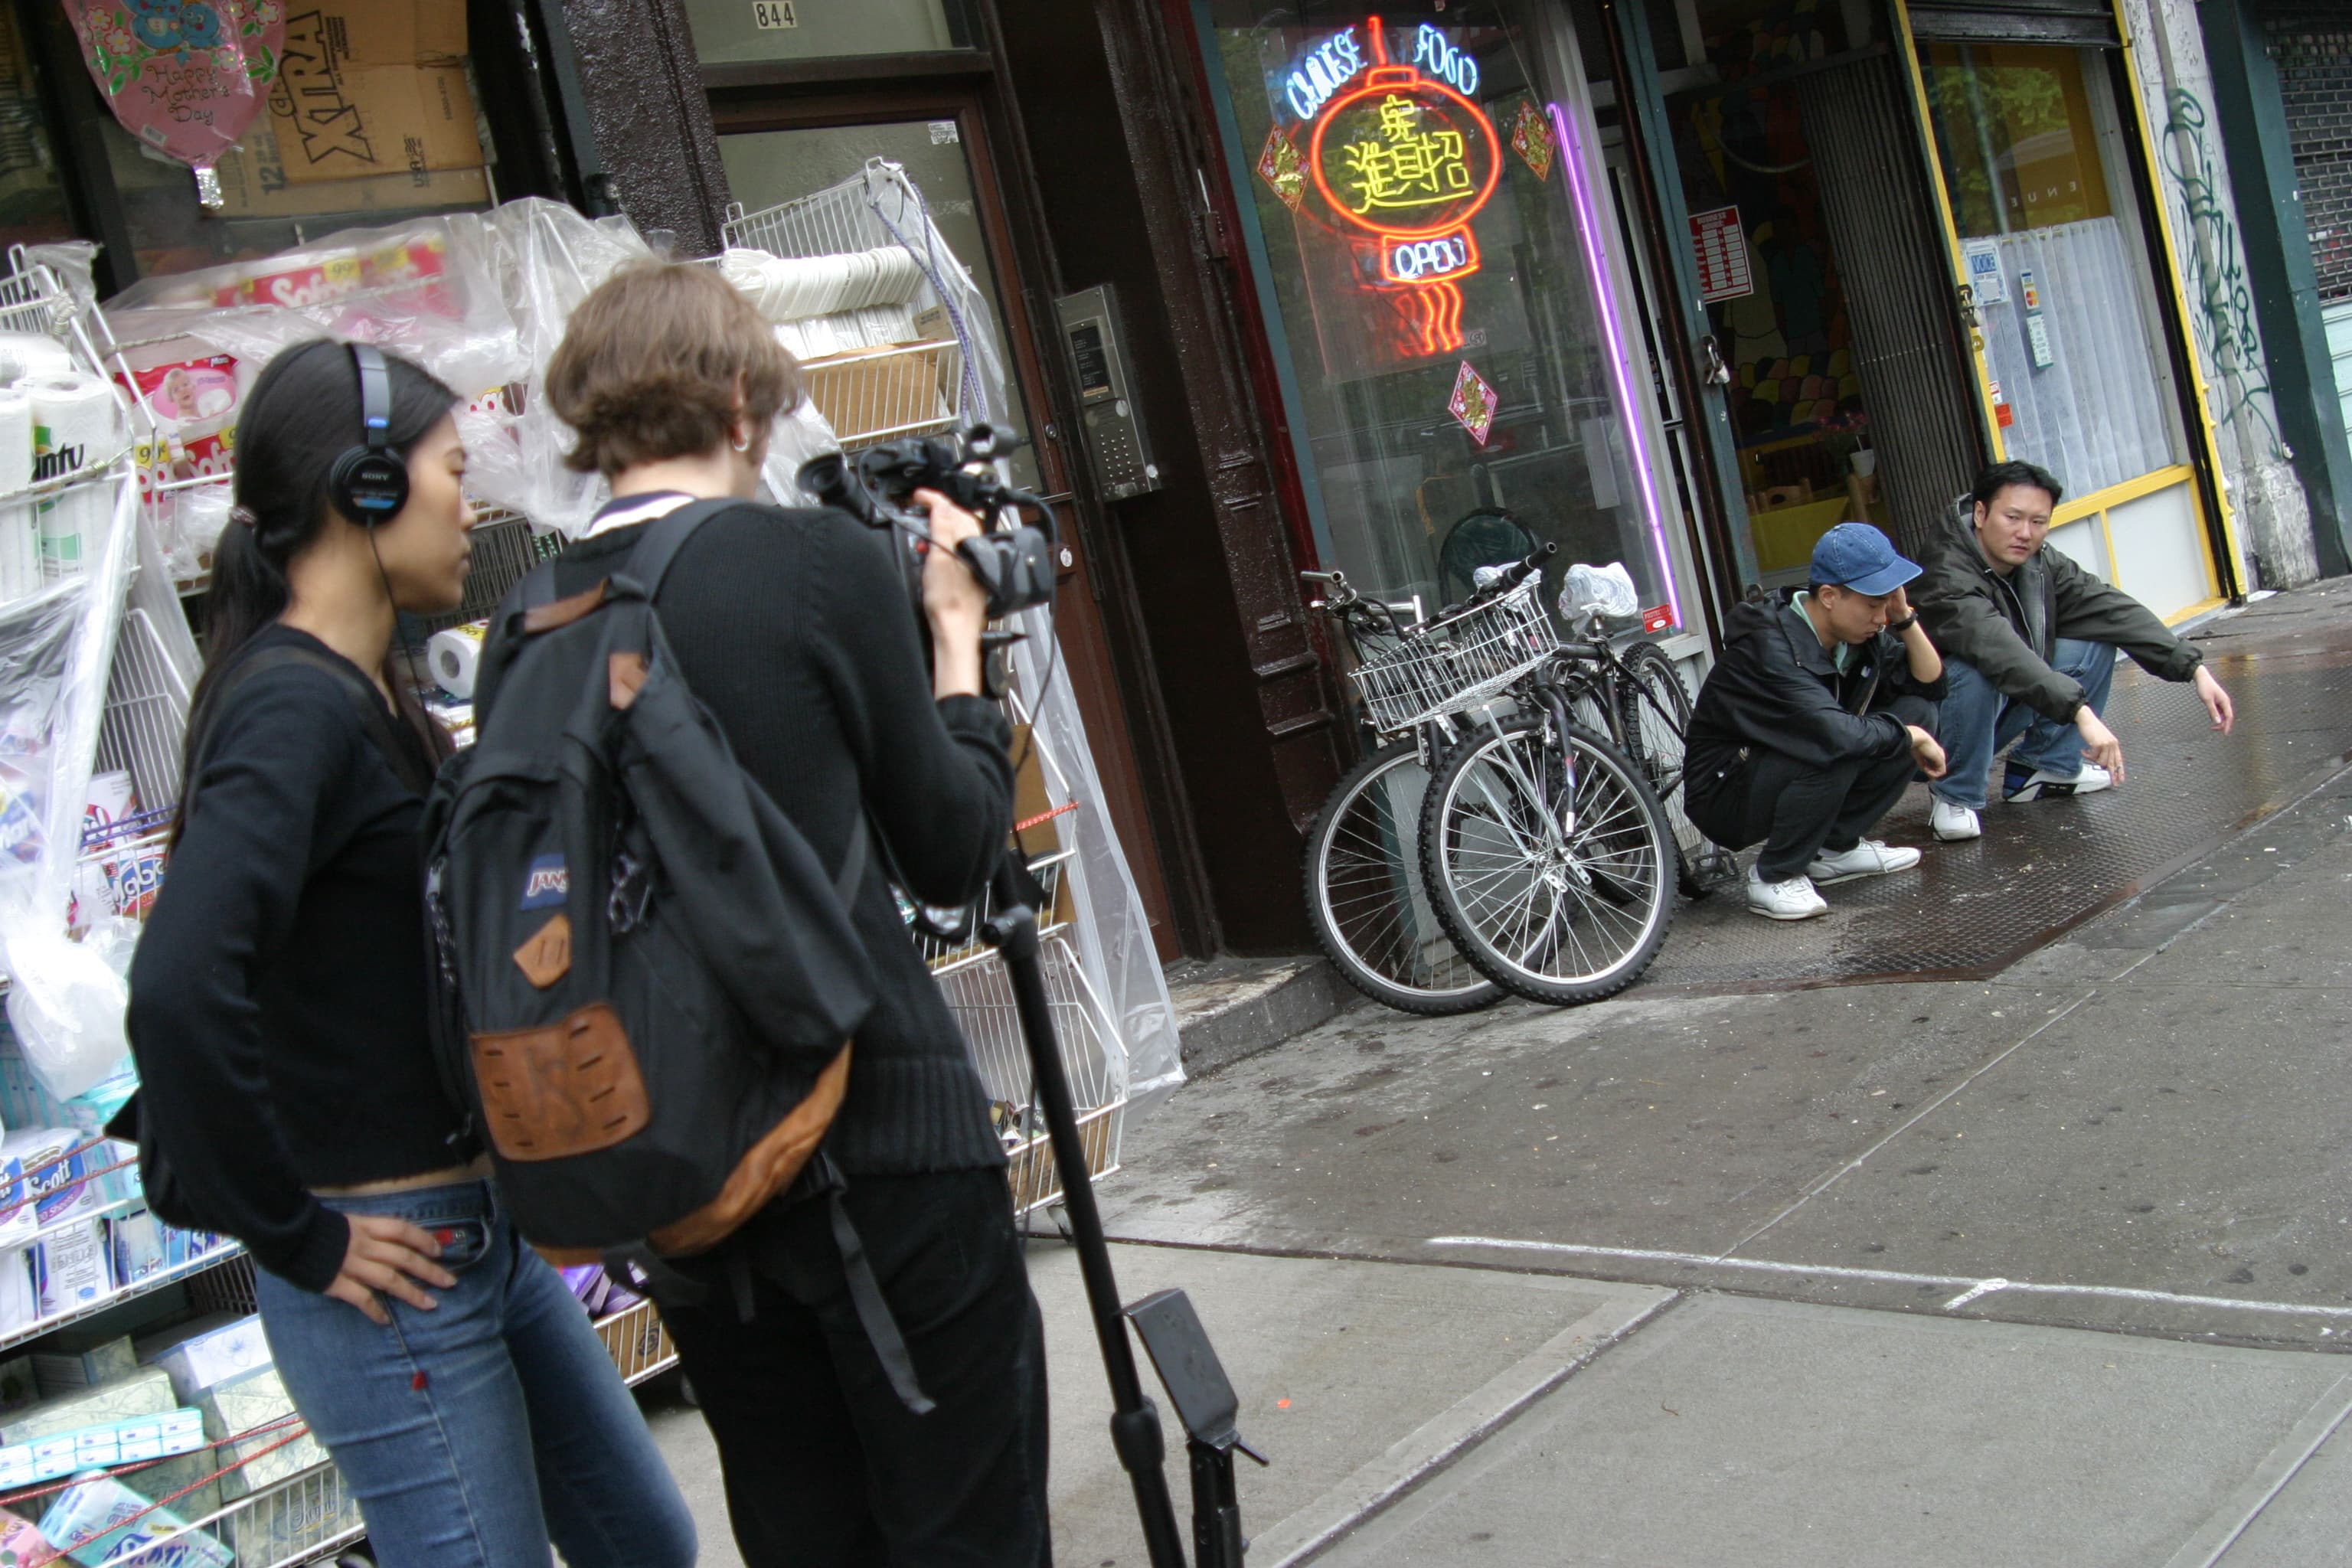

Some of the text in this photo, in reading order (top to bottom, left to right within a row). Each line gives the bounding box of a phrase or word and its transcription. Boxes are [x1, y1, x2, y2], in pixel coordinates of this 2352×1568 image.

[756, 2, 794, 27] 844
[145, 64, 217, 85] Happy
[279, 10, 376, 164] XTRA
[1286, 24, 1478, 119] CHINESE FOOD
[141, 84, 230, 106] Mother's
[168, 105, 214, 126] Day
[1394, 238, 1466, 279] OPEN
[26, 1158, 73, 1205] Scott
